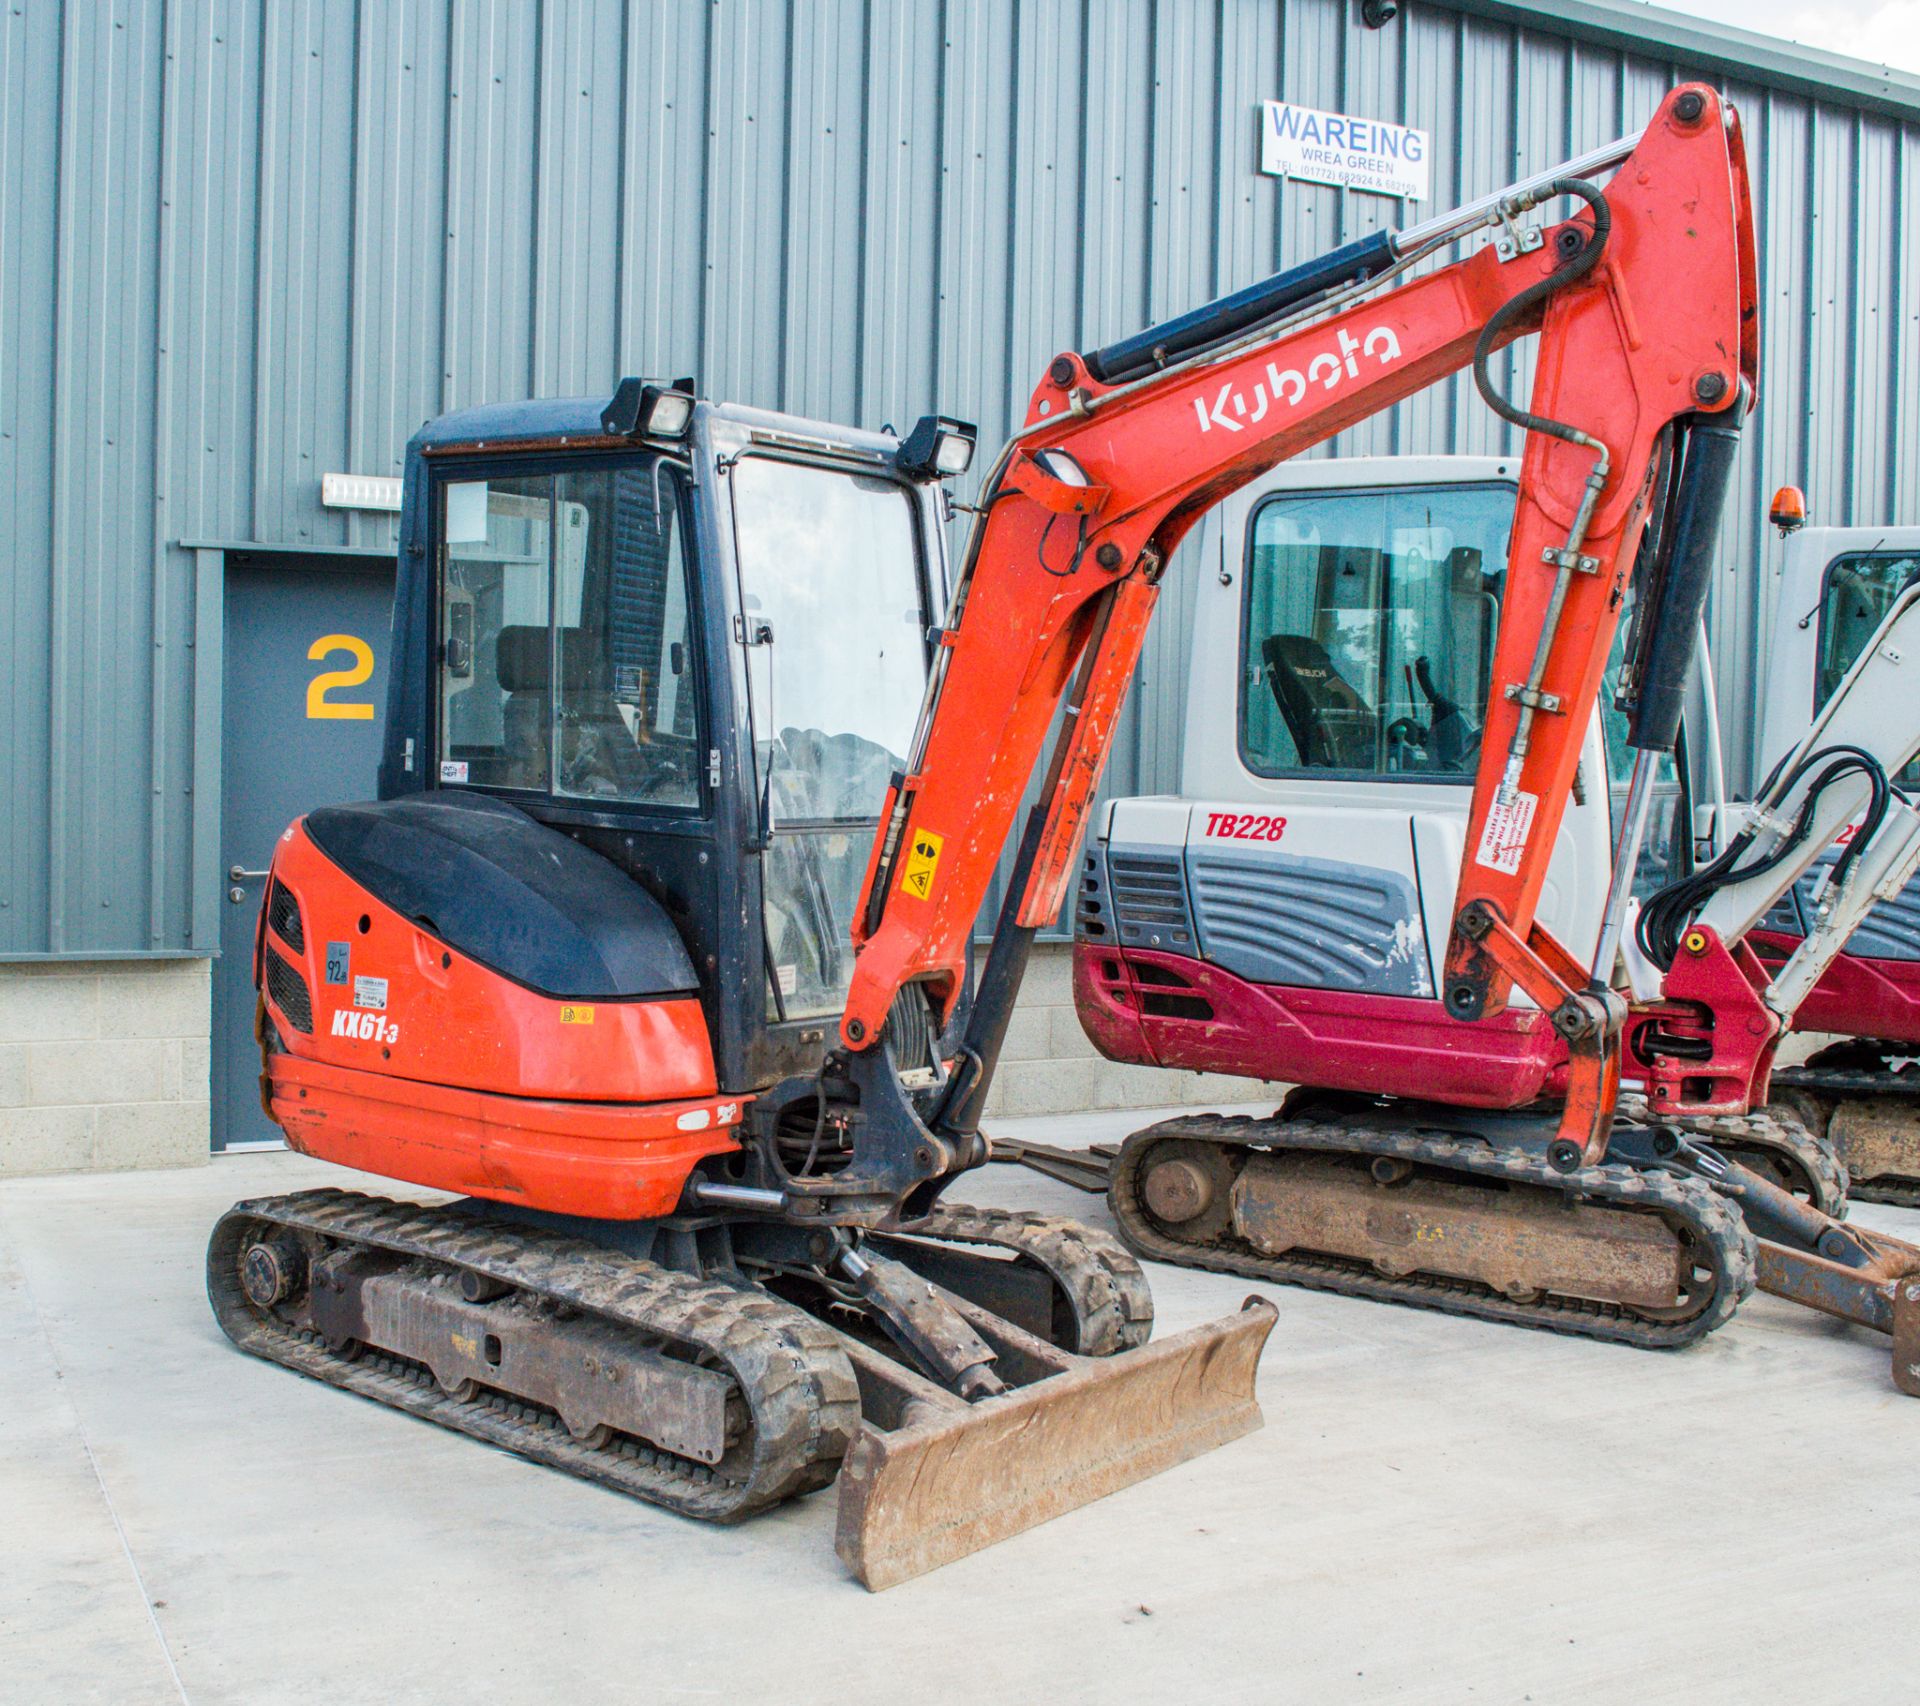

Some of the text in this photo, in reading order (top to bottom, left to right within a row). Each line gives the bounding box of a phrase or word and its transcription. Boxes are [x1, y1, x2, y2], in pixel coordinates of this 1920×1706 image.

[1272, 106, 1422, 162] WAREING
[1300, 165, 1336, 182] (01772)
[1338, 171, 1373, 187] 682924
[1302, 146, 1395, 175] WREA GREEN
[1193, 326, 1403, 433] Kubota
[306, 633, 375, 720] 2
[1205, 813, 1287, 842] TB228
[327, 959, 341, 981] 92
[331, 1009, 399, 1044] KX61-3
